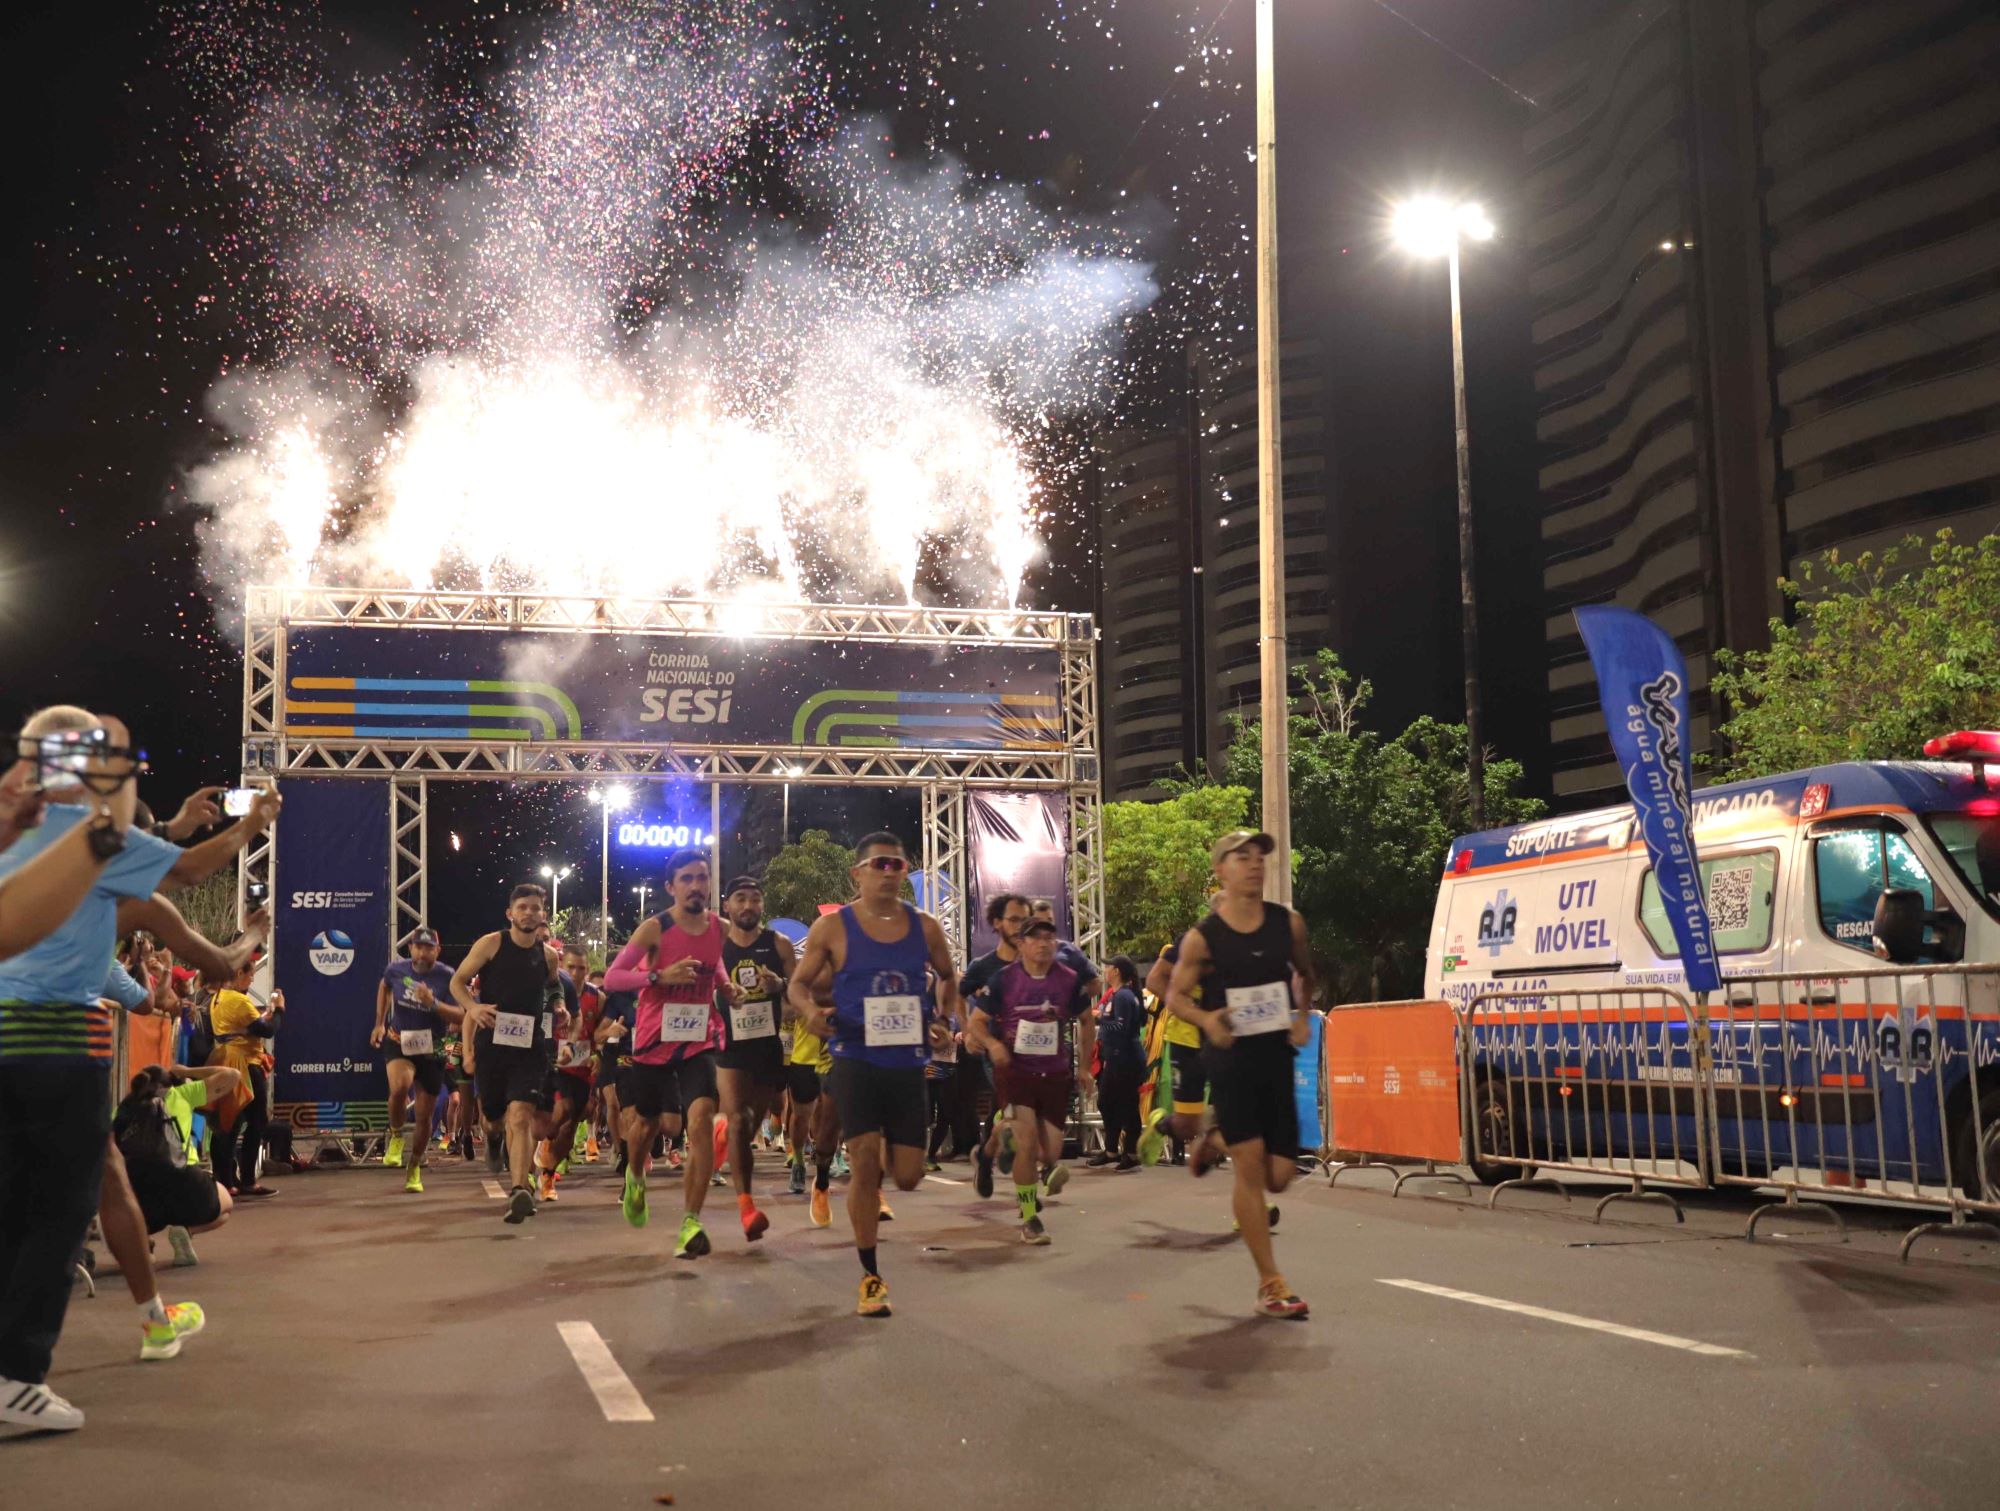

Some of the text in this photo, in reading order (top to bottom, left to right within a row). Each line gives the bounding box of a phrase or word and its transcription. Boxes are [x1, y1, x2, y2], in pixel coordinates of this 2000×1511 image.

[648, 653, 709, 668] CORRIDA
[646, 670, 735, 685] NACIONAL DO
[640, 688, 733, 723] SESI
[1627, 704, 1712, 964] água mineral natural
[1504, 828, 1578, 857] SUPORTE
[291, 892, 332, 908] SESI
[1558, 879, 1597, 911] UTI
[1535, 917, 1611, 954] MÓVEL
[1836, 920, 1874, 938] RESGAT
[316, 953, 348, 964] YARA
[1625, 974, 1643, 985] SUA
[1645, 974, 1665, 984] VIDA
[1667, 973, 1681, 984] EM
[872, 1014, 915, 1030] 5036
[291, 1063, 325, 1073] CORRER
[326, 1063, 341, 1073] FAZ
[353, 1063, 372, 1073] BEM
